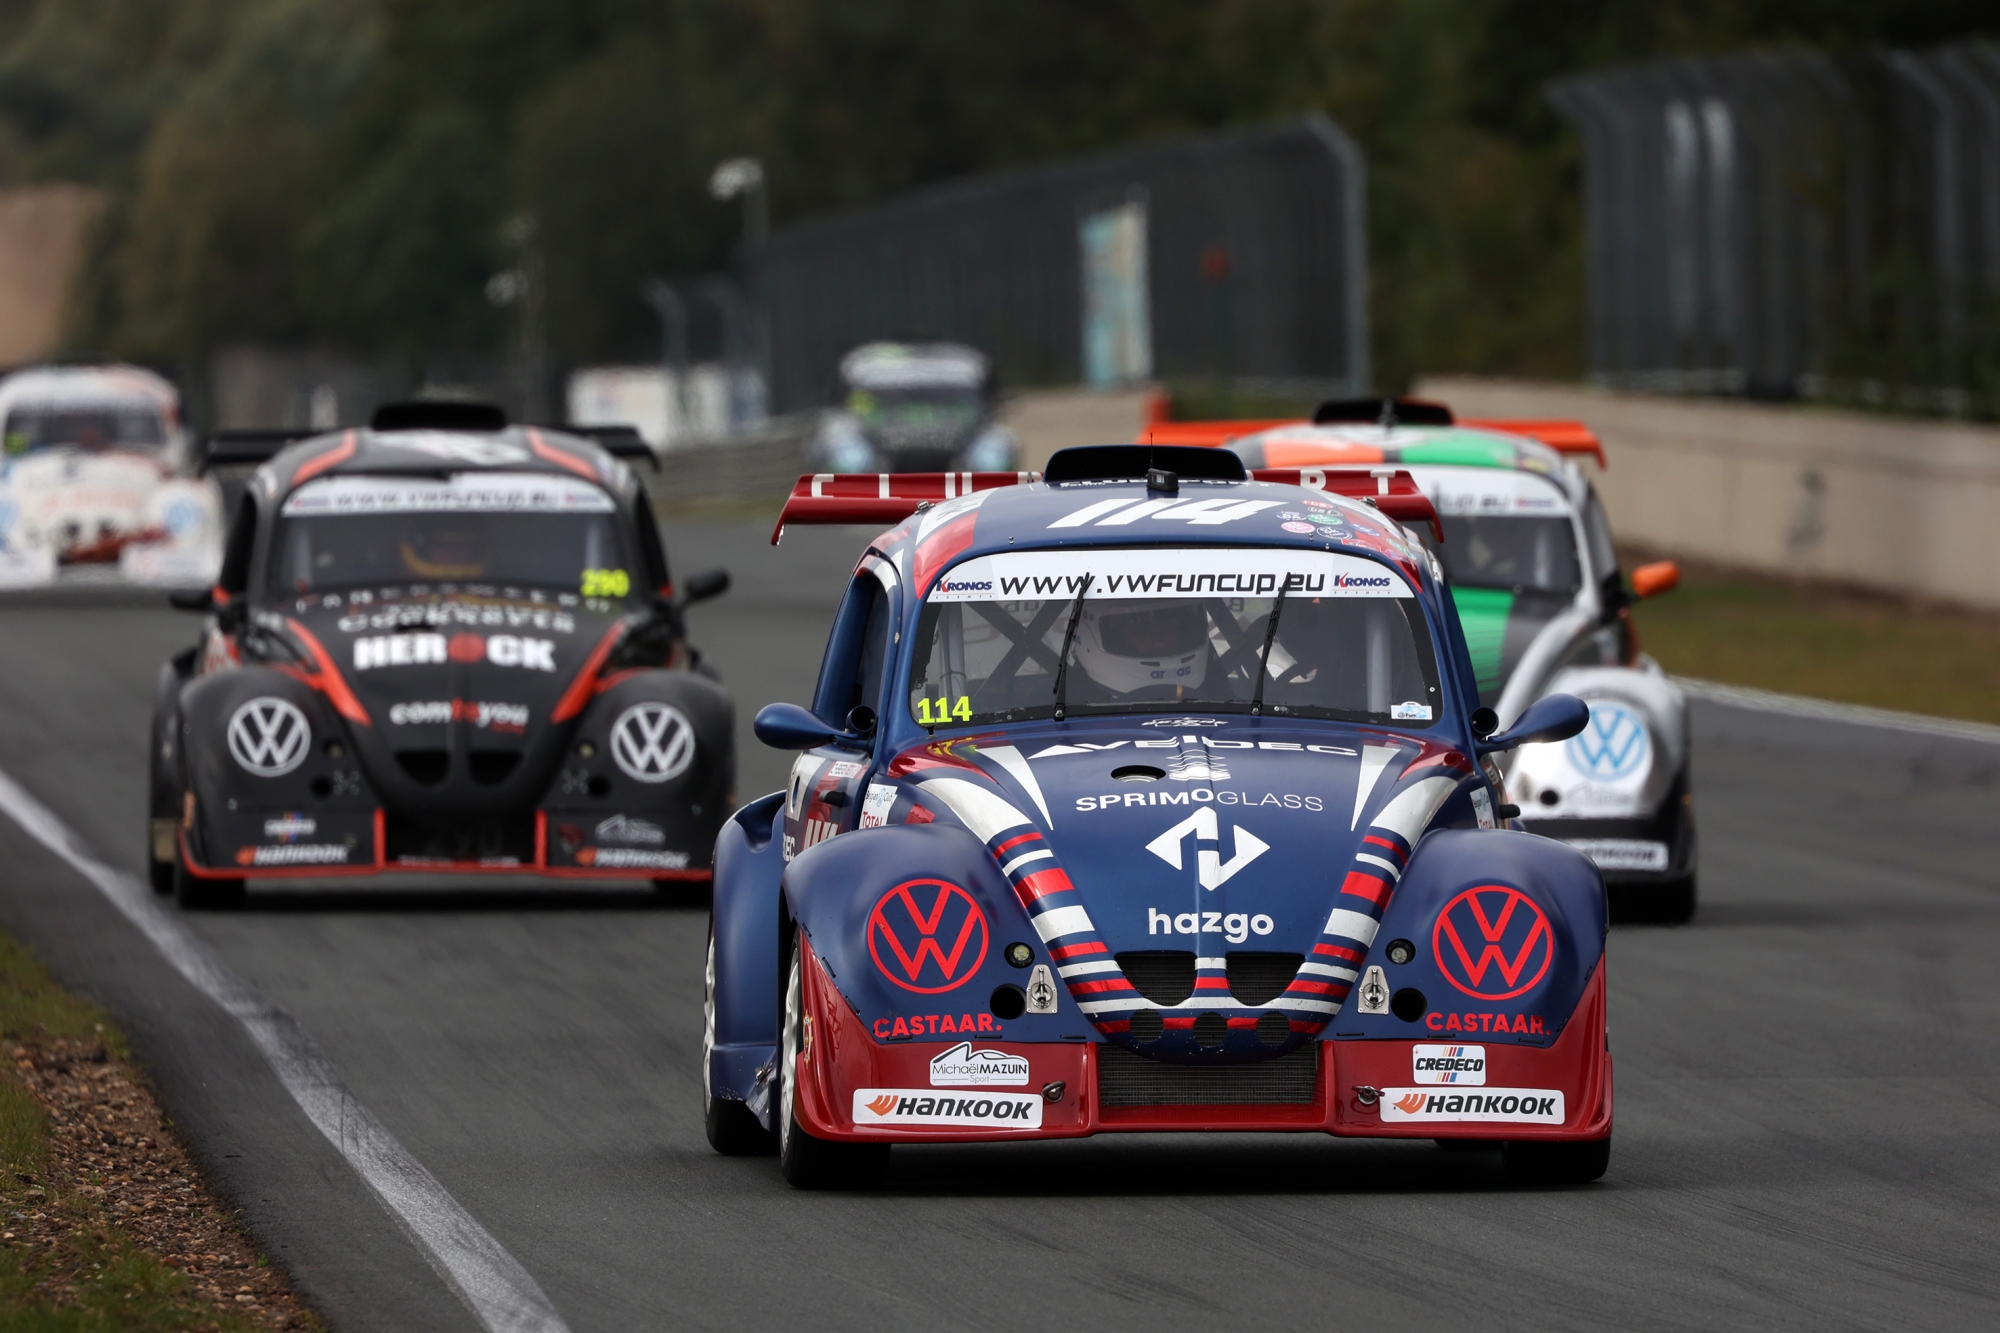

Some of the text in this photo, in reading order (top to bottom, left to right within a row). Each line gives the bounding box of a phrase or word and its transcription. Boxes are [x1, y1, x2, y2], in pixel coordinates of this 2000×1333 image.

[1046, 498, 1289, 529] 114
[581, 569, 630, 597] 290
[936, 577, 992, 592] KRONOS
[1000, 573, 1325, 596] WWW.VWFUNCUP.EU
[1334, 571, 1391, 588] KRONOS
[917, 696, 973, 724] 114
[1075, 788, 1324, 812] SPRIMOGLASS
[1149, 908, 1275, 944] hazgo
[1415, 1057, 1484, 1072] CREDECO
[970, 1075, 990, 1084] Sport
[896, 1097, 1034, 1121] HANKOOK
[1425, 1095, 1556, 1116] HANKOOK
